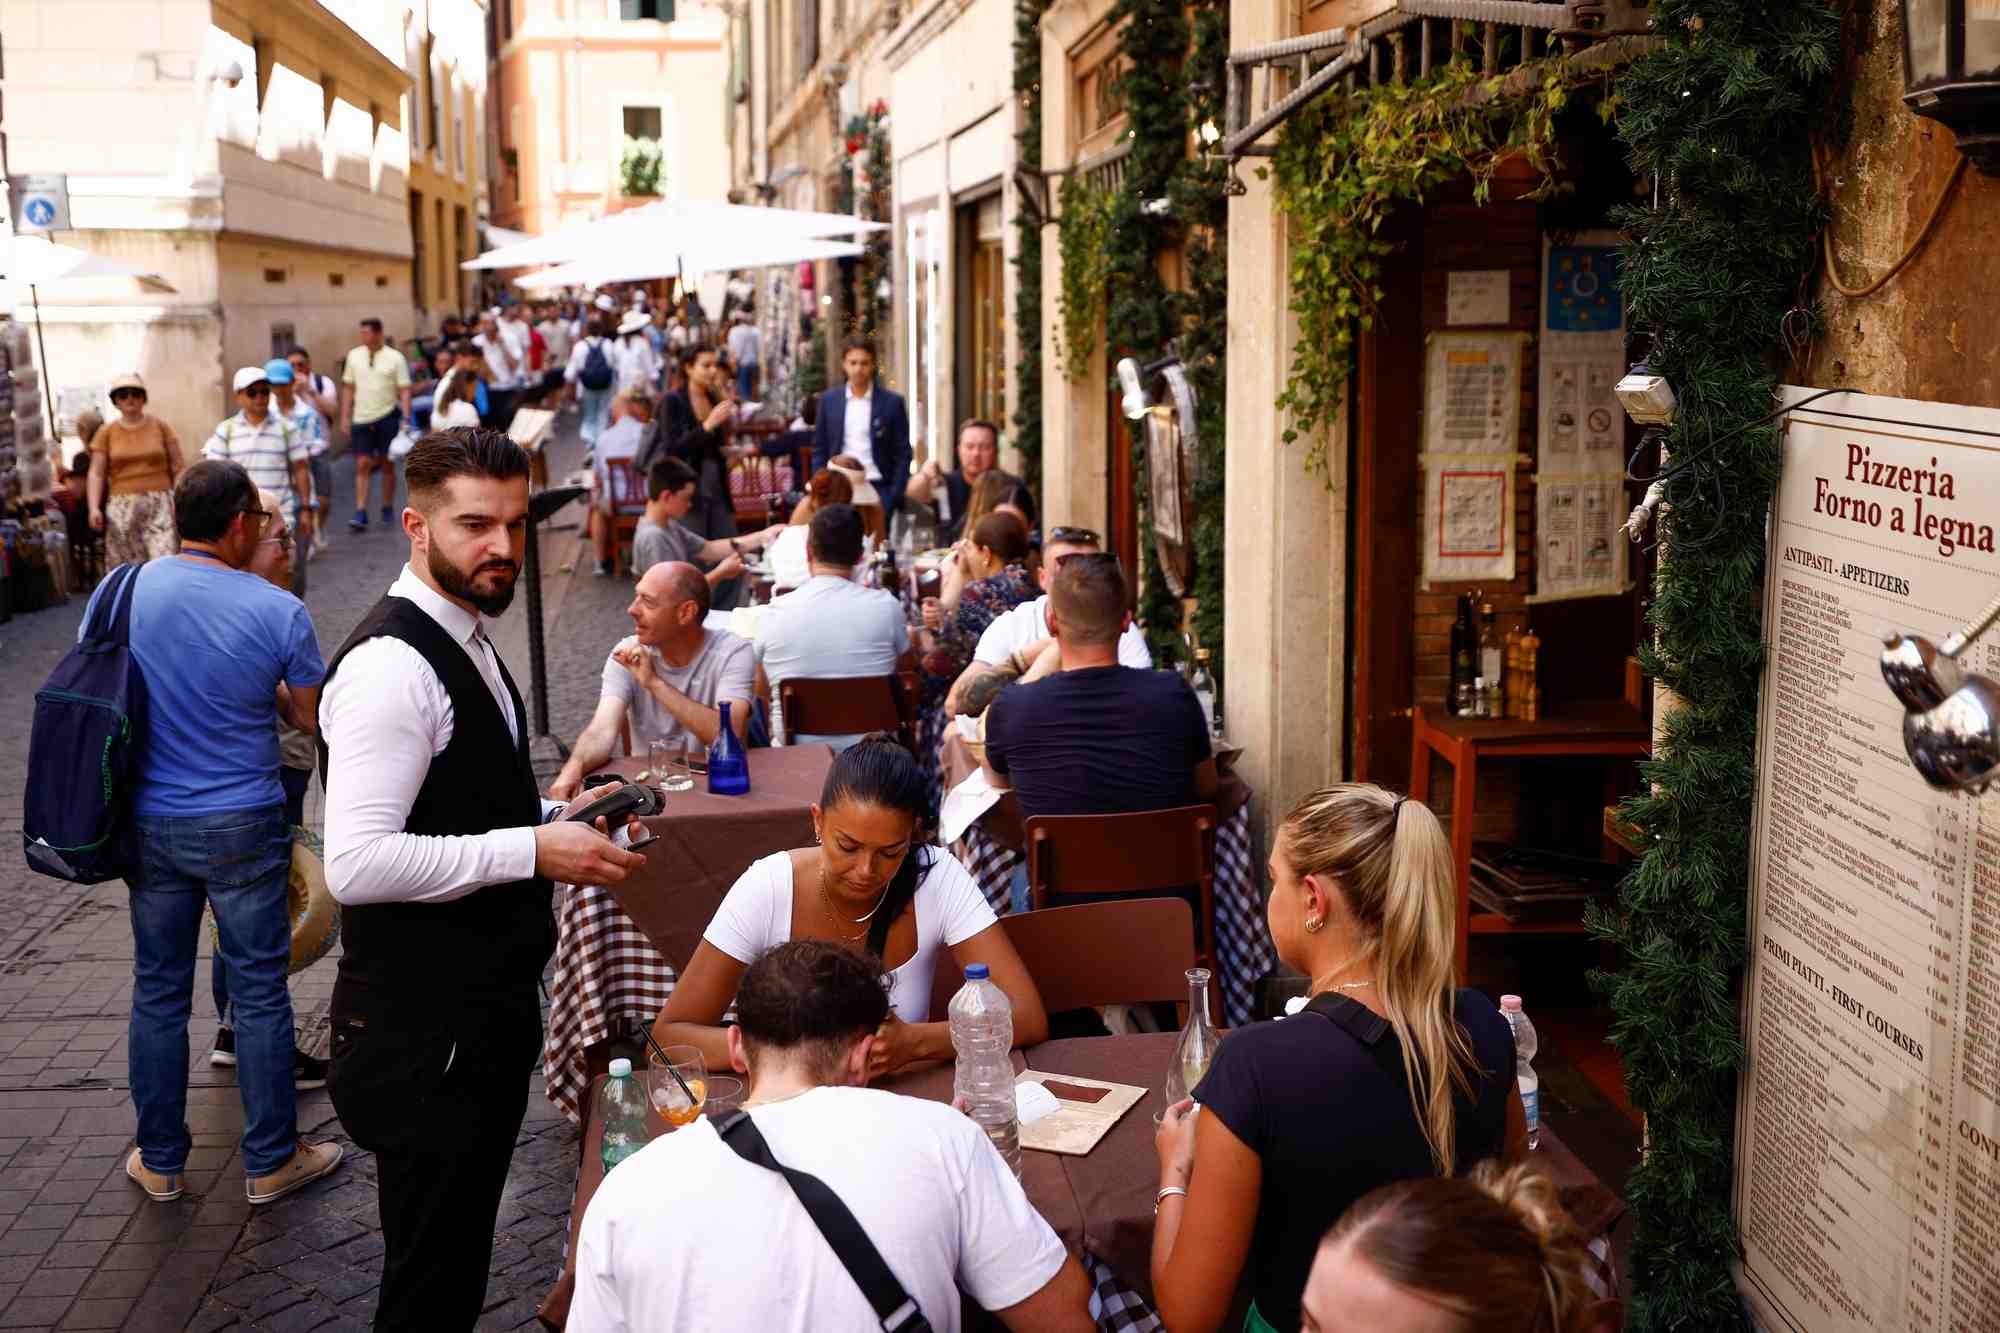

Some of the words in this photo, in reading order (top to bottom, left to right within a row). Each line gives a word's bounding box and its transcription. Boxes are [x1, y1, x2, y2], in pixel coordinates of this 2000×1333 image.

[1845, 443, 1955, 500] Pizzeria
[1813, 477, 1882, 527] Forno
[1890, 507, 1905, 533] a
[1913, 498, 1995, 557] legna
[1783, 546, 1833, 575] ANTIPASTI
[1839, 562, 1910, 596] APPETIZERS
[1763, 935, 1790, 965] PRIMI
[1792, 956, 1824, 992] PIATTI
[1831, 985, 1864, 1020] FIRST
[1866, 1009, 1924, 1062] COURSES
